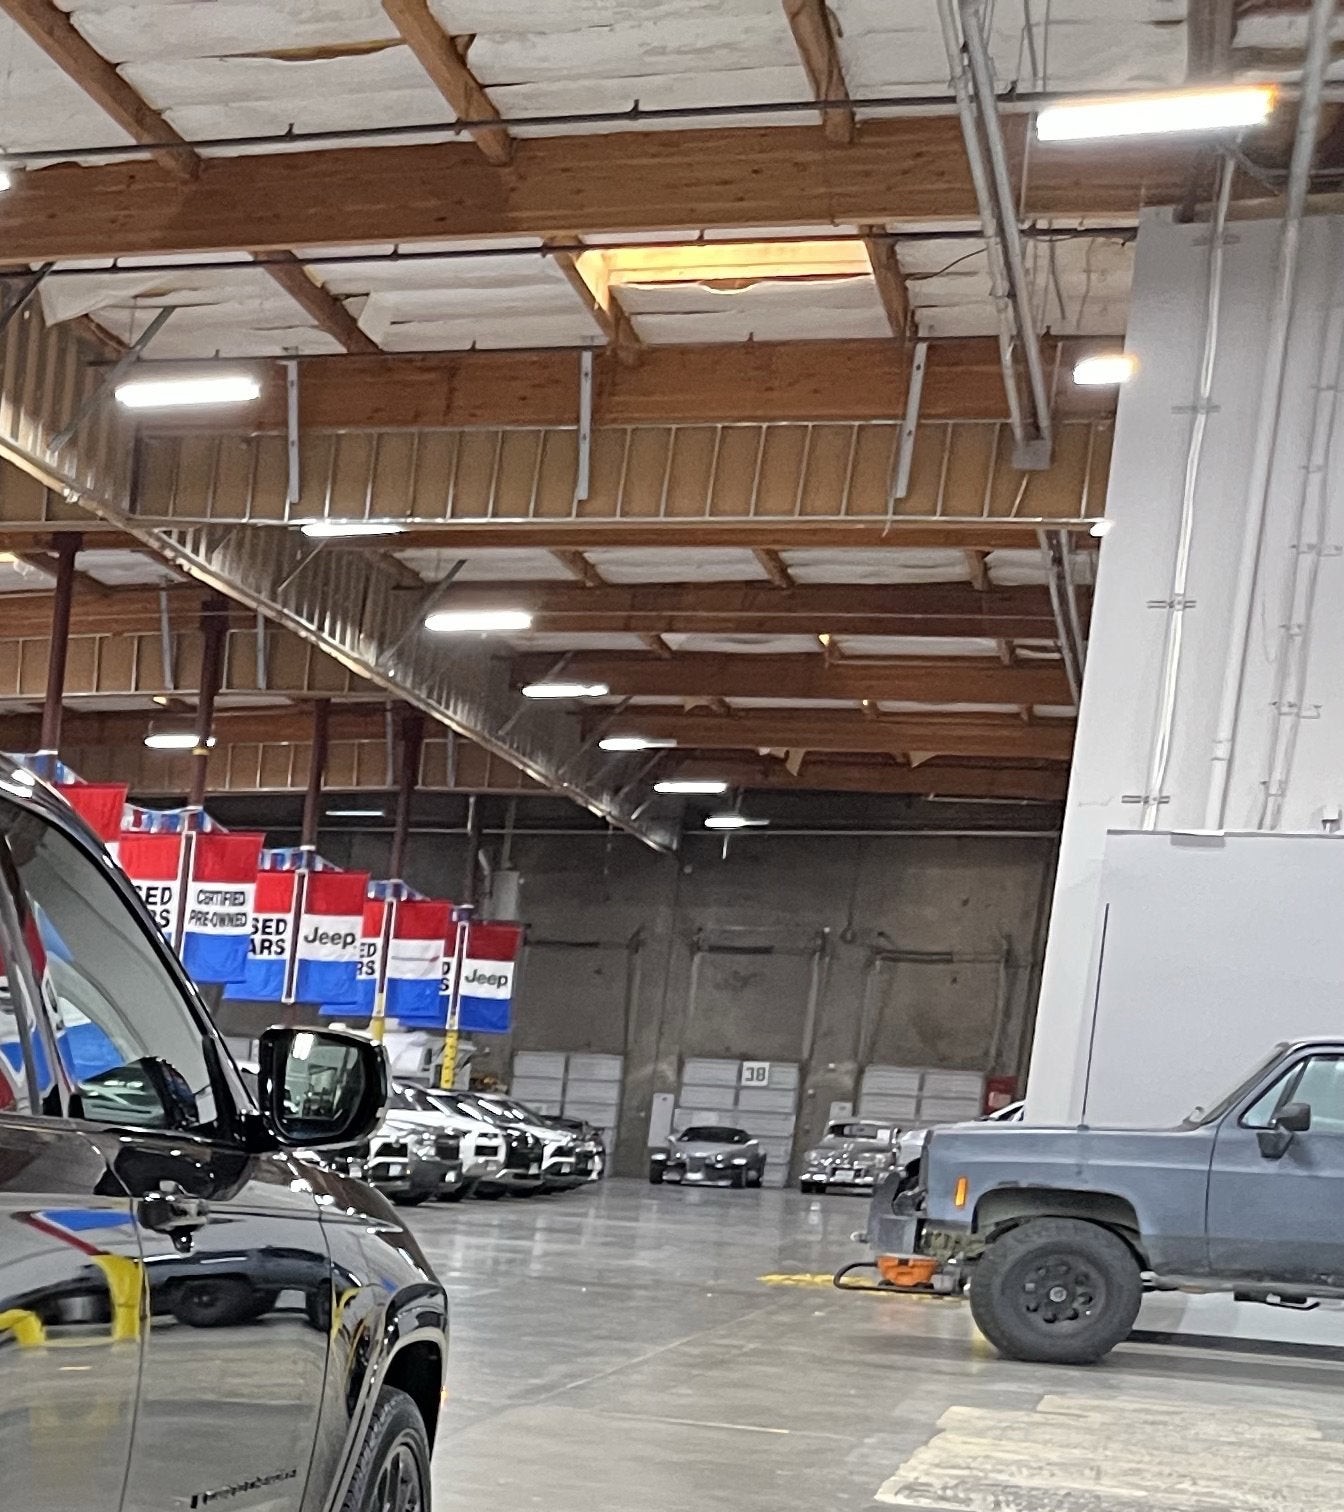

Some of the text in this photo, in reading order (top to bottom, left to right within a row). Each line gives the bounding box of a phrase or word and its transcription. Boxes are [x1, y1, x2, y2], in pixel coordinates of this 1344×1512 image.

[197, 889, 246, 906] CERTIFIED
[188, 910, 248, 928] PRE-OWNED
[251, 918, 288, 936] SED
[248, 938, 286, 956] ARS
[303, 926, 357, 950] Jeep
[465, 968, 508, 989] Jeep
